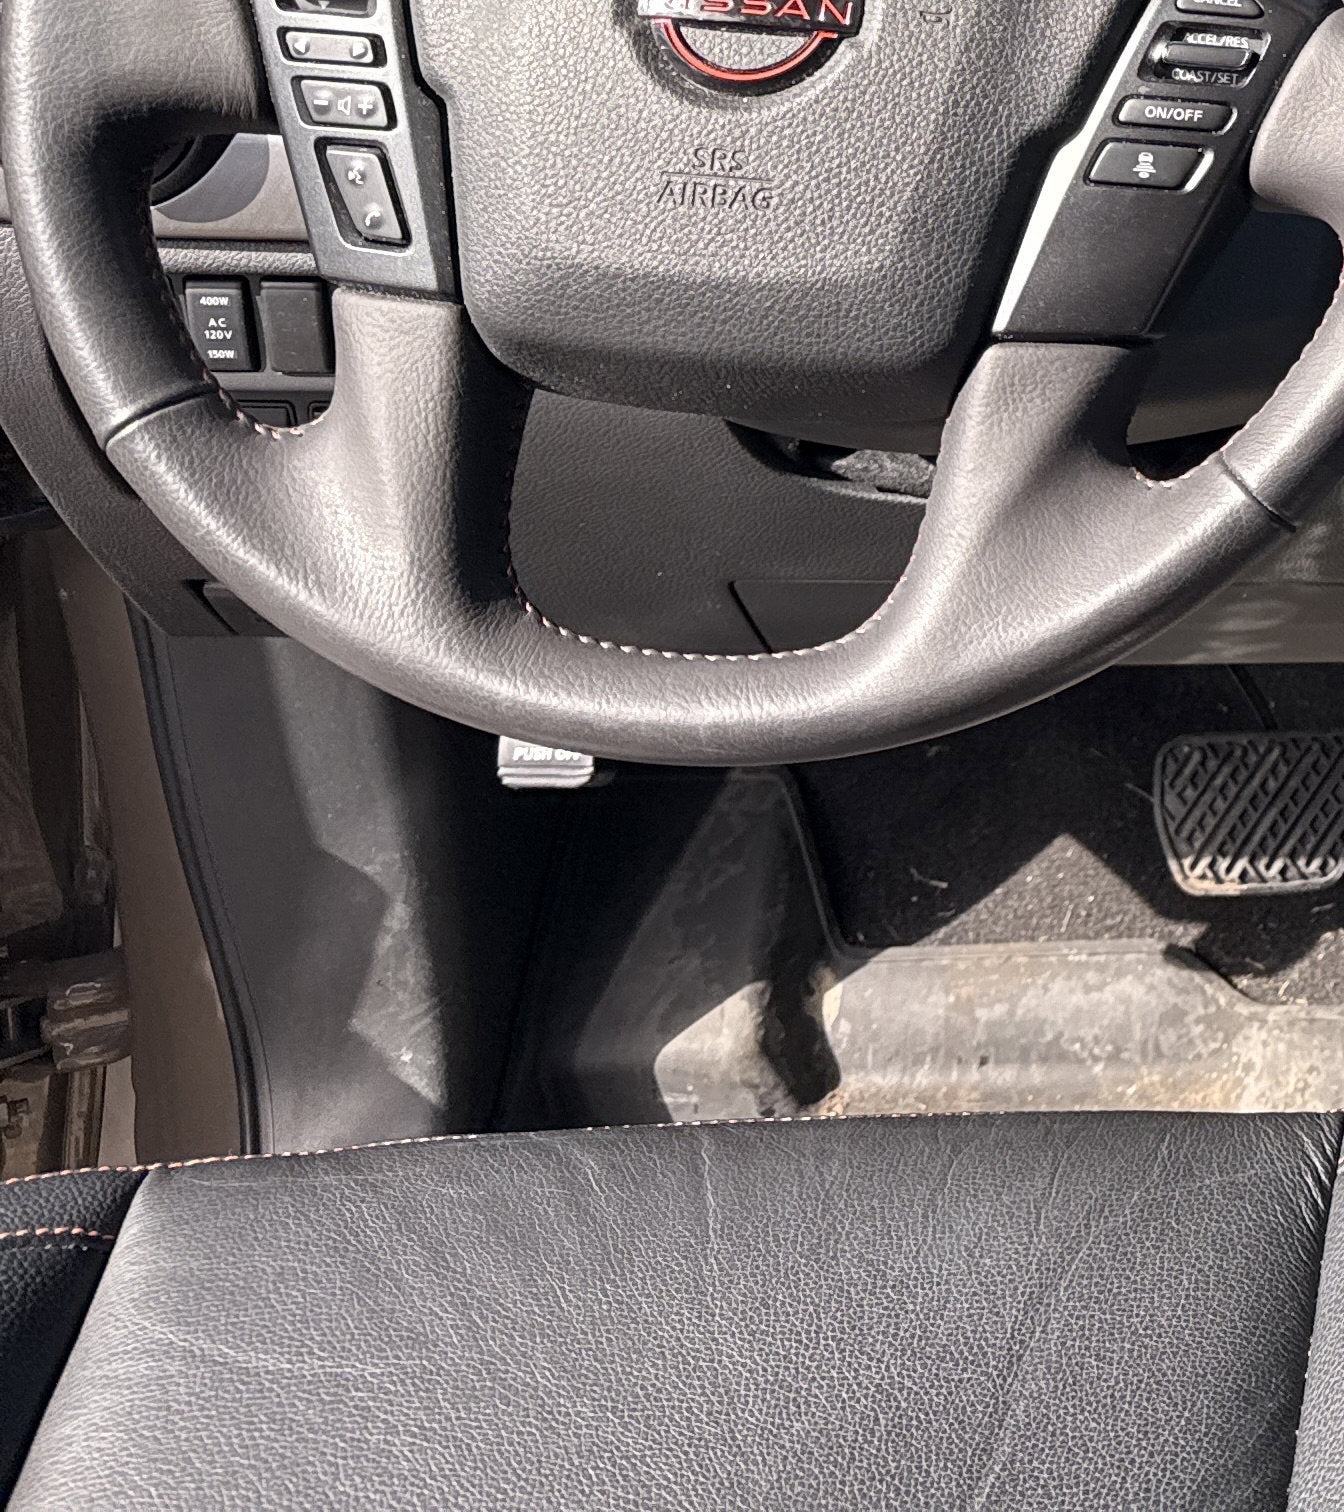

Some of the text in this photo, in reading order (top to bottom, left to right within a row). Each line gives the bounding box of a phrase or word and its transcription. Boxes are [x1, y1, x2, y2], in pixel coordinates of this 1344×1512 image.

[1184, 32, 1250, 50] ACCEL/RES
[1171, 67, 1239, 87] COAST/SET
[1144, 105, 1204, 122] ON/OFF
[692, 146, 747, 173] SRS
[655, 180, 775, 211] AIRBAG
[199, 296, 230, 306] 400W
[203, 329, 233, 340] 120V
[206, 349, 235, 359] 150W
[512, 746, 553, 761] PUSH
